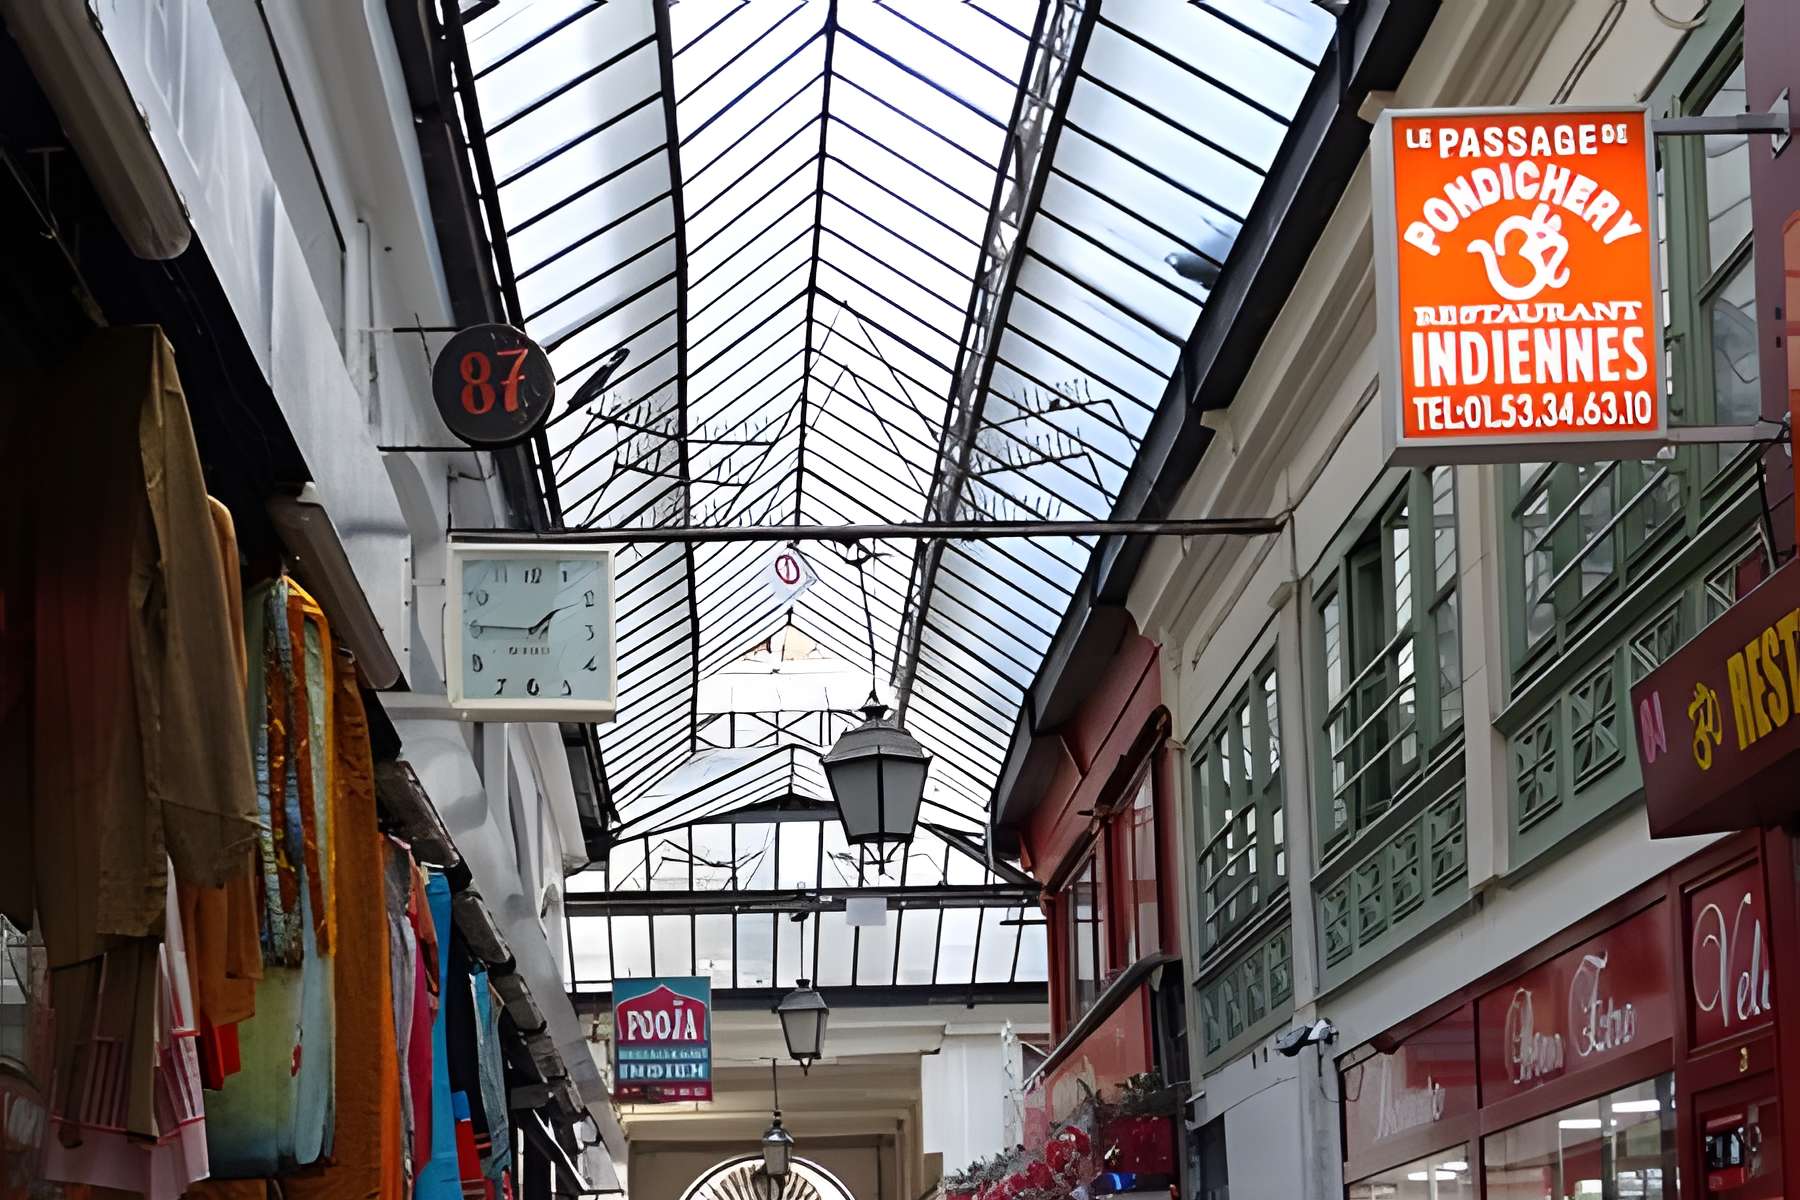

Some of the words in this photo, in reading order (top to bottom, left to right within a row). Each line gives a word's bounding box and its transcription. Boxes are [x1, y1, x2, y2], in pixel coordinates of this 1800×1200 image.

[1406, 127, 1432, 149] LE
[1438, 123, 1598, 159] PASSAGE
[1403, 159, 1642, 257] PONDICHERY
[459, 348, 528, 415] 87
[1412, 326, 1649, 388] INDIENNES
